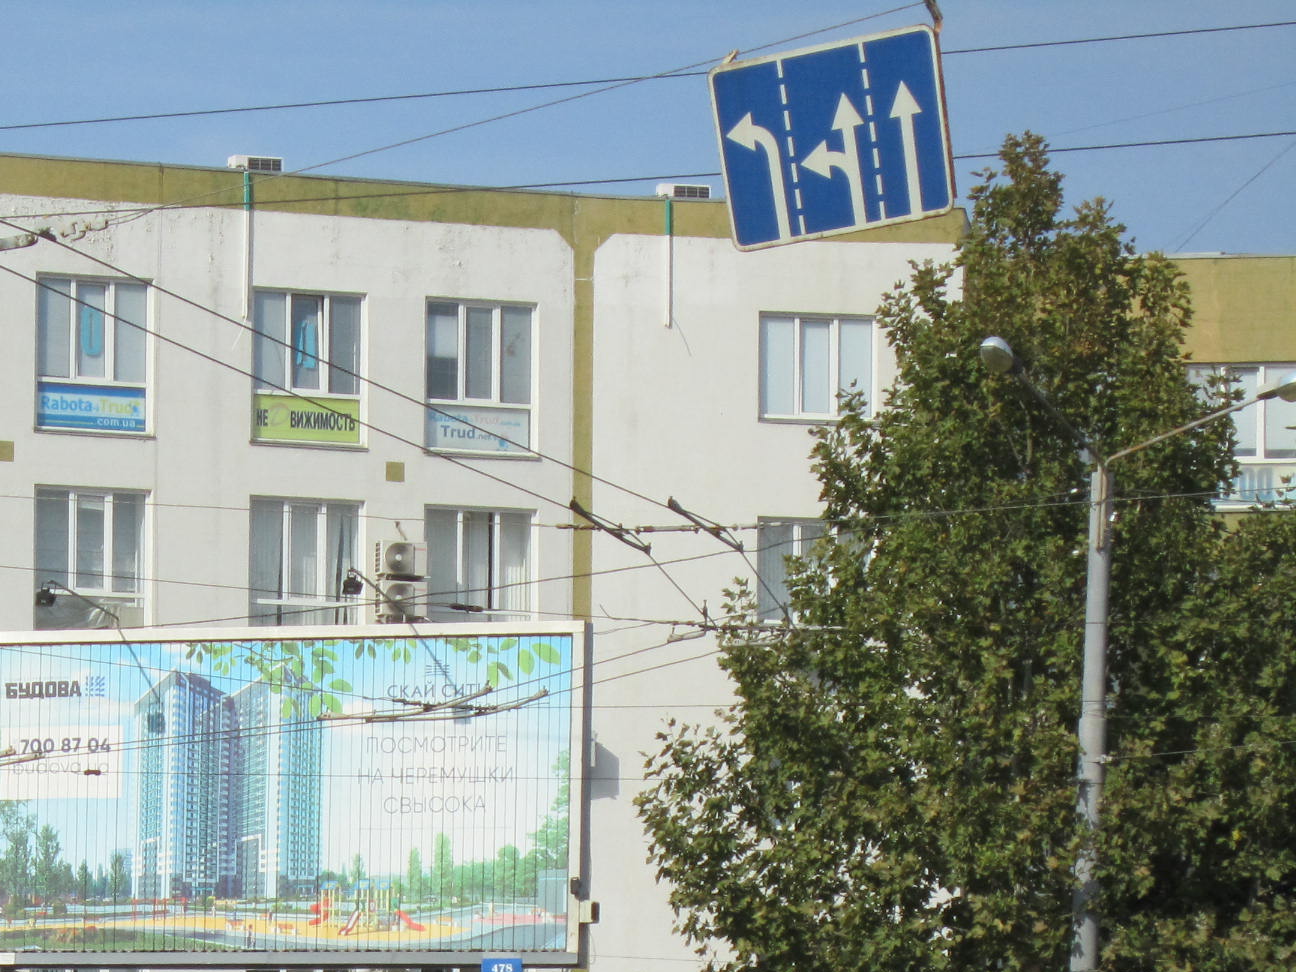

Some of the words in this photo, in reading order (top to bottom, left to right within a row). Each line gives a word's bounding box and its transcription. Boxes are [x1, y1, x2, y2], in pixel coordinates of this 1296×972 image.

[5, 680, 82, 699] БУДОВА
[386, 680, 436, 699] СКАЙ
[61, 738, 82, 752] 87
[88, 738, 111, 753] 04
[366, 735, 507, 754] ПОСМОТРИТЕ
[357, 768, 384, 785] НА
[391, 766, 514, 785] ЧЕРЕМУШКИ
[383, 795, 486, 814] СВЫСОКА
